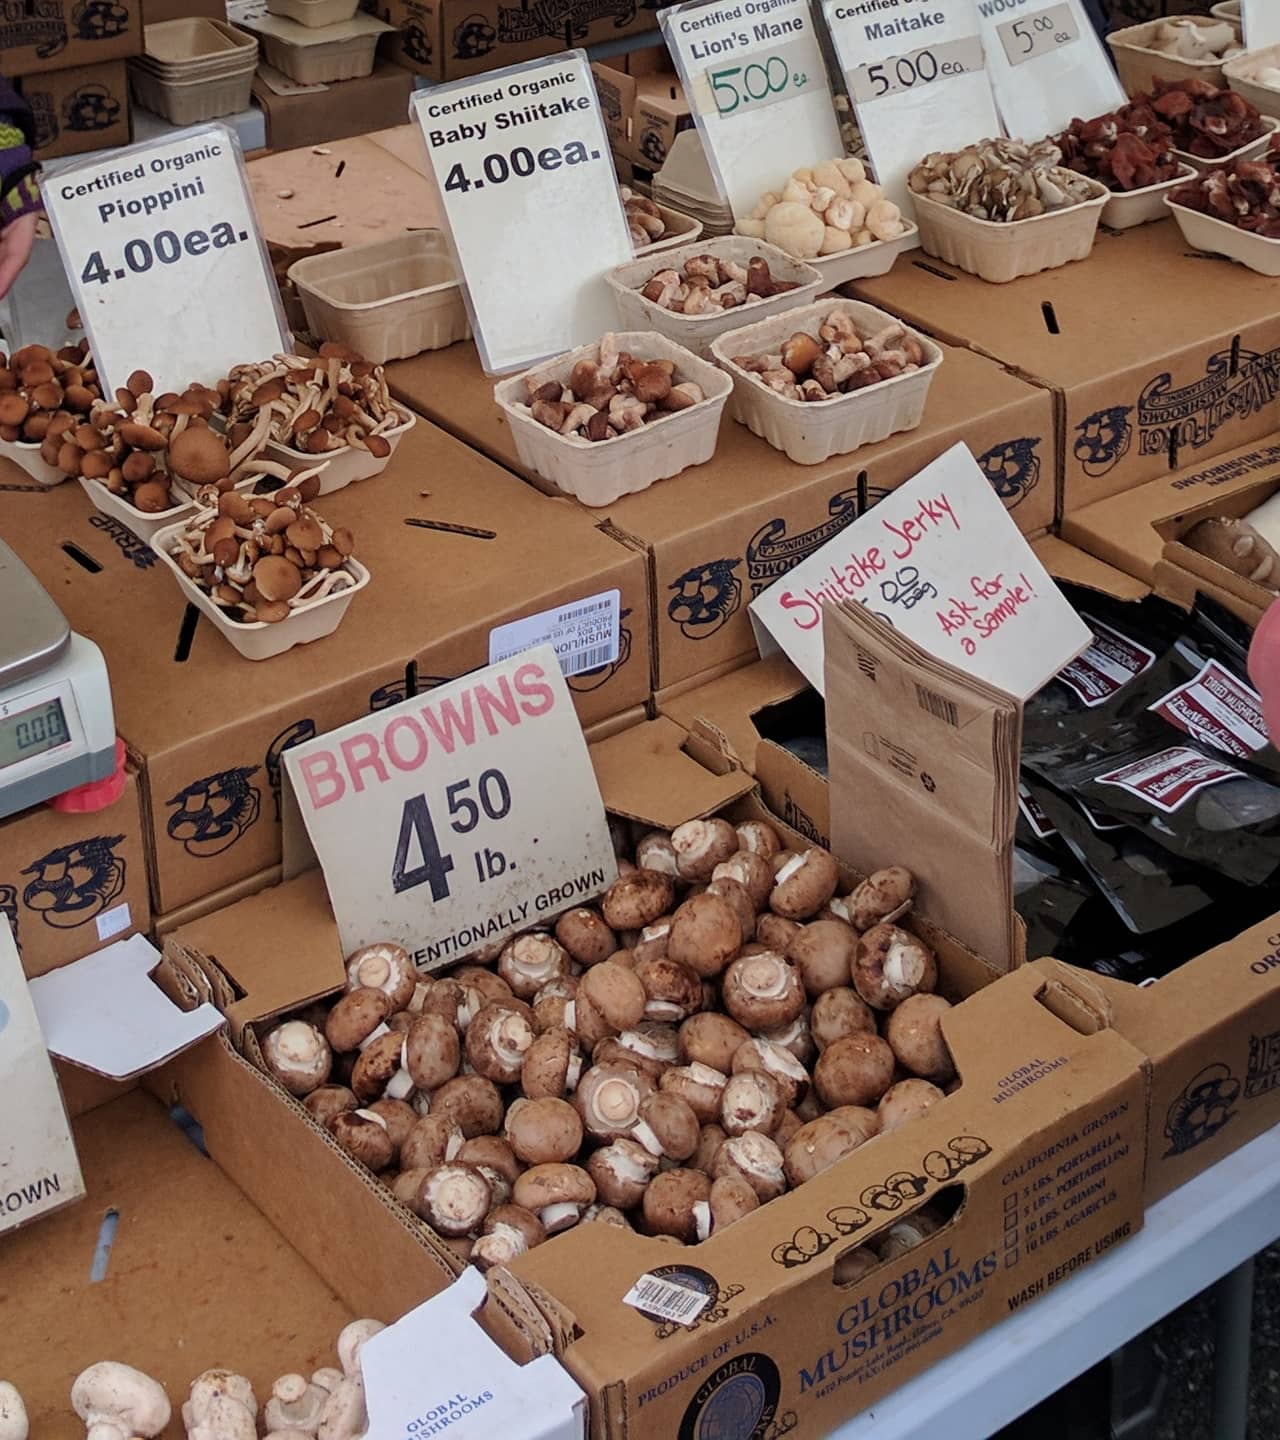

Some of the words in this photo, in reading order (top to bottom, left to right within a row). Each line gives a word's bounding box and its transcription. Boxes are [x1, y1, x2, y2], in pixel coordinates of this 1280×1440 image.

[679, 6, 743, 34] Certified
[690, 30, 750, 60] Lion's
[753, 16, 804, 42] Mane
[864, 10, 946, 41] Maitake
[427, 85, 510, 118] Certified
[511, 71, 576, 107] Organic
[711, 56, 789, 113] 5.00
[868, 50, 939, 97] 5.00
[428, 118, 488, 149] Baby
[493, 92, 592, 132] Shiitake
[60, 163, 147, 202] Certified
[150, 144, 222, 179] Organic
[443, 138, 601, 194] 4.00ea.
[98, 175, 208, 225] Pioppini
[80, 221, 250, 287] 4.00ea.
[1171, 449, 1265, 490] MUSHROOMS
[780, 547, 886, 630] Shiitake
[881, 493, 961, 559] Jerky
[902, 581, 938, 609] bag
[935, 597, 979, 638] Ask
[972, 572, 1004, 599] for
[960, 636, 977, 656] a
[972, 572, 1038, 639] sample!
[1204, 676, 1228, 700] DRIED
[15, 712, 63, 750] 0.00
[299, 663, 555, 810] BROWNS
[474, 848, 517, 883] lb.
[535, 868, 606, 911] GROWN
[993, 1056, 1069, 1104] MUSHROOMS
[997, 1058, 1046, 1089] GLOBAL
[1002, 1134, 1079, 1186] CALIFORNIA
[1081, 1102, 1129, 1138] GROWN
[1056, 1132, 1121, 1177] PORTABELLA
[1057, 1145, 1130, 1195] PORTABELLINI
[1025, 1219, 1037, 1236] 10
[1063, 1177, 1106, 1210] CRIMINI
[1026, 1240, 1038, 1256] 10
[1063, 1190, 1118, 1229] AGARICUS
[1007, 1278, 1045, 1311] WASH
[1047, 1247, 1092, 1286] BEFORE
[1095, 1221, 1132, 1255] USING
[836, 1248, 960, 1335] GLOBAL
[798, 1250, 998, 1394] MUSHROOMS
[637, 1355, 709, 1408] PRODUCE
[713, 1342, 730, 1360] OF
[735, 1314, 777, 1345] U.S.A.
[697, 1356, 759, 1405] GLOBAL
[406, 1391, 469, 1434] GLOBAL
